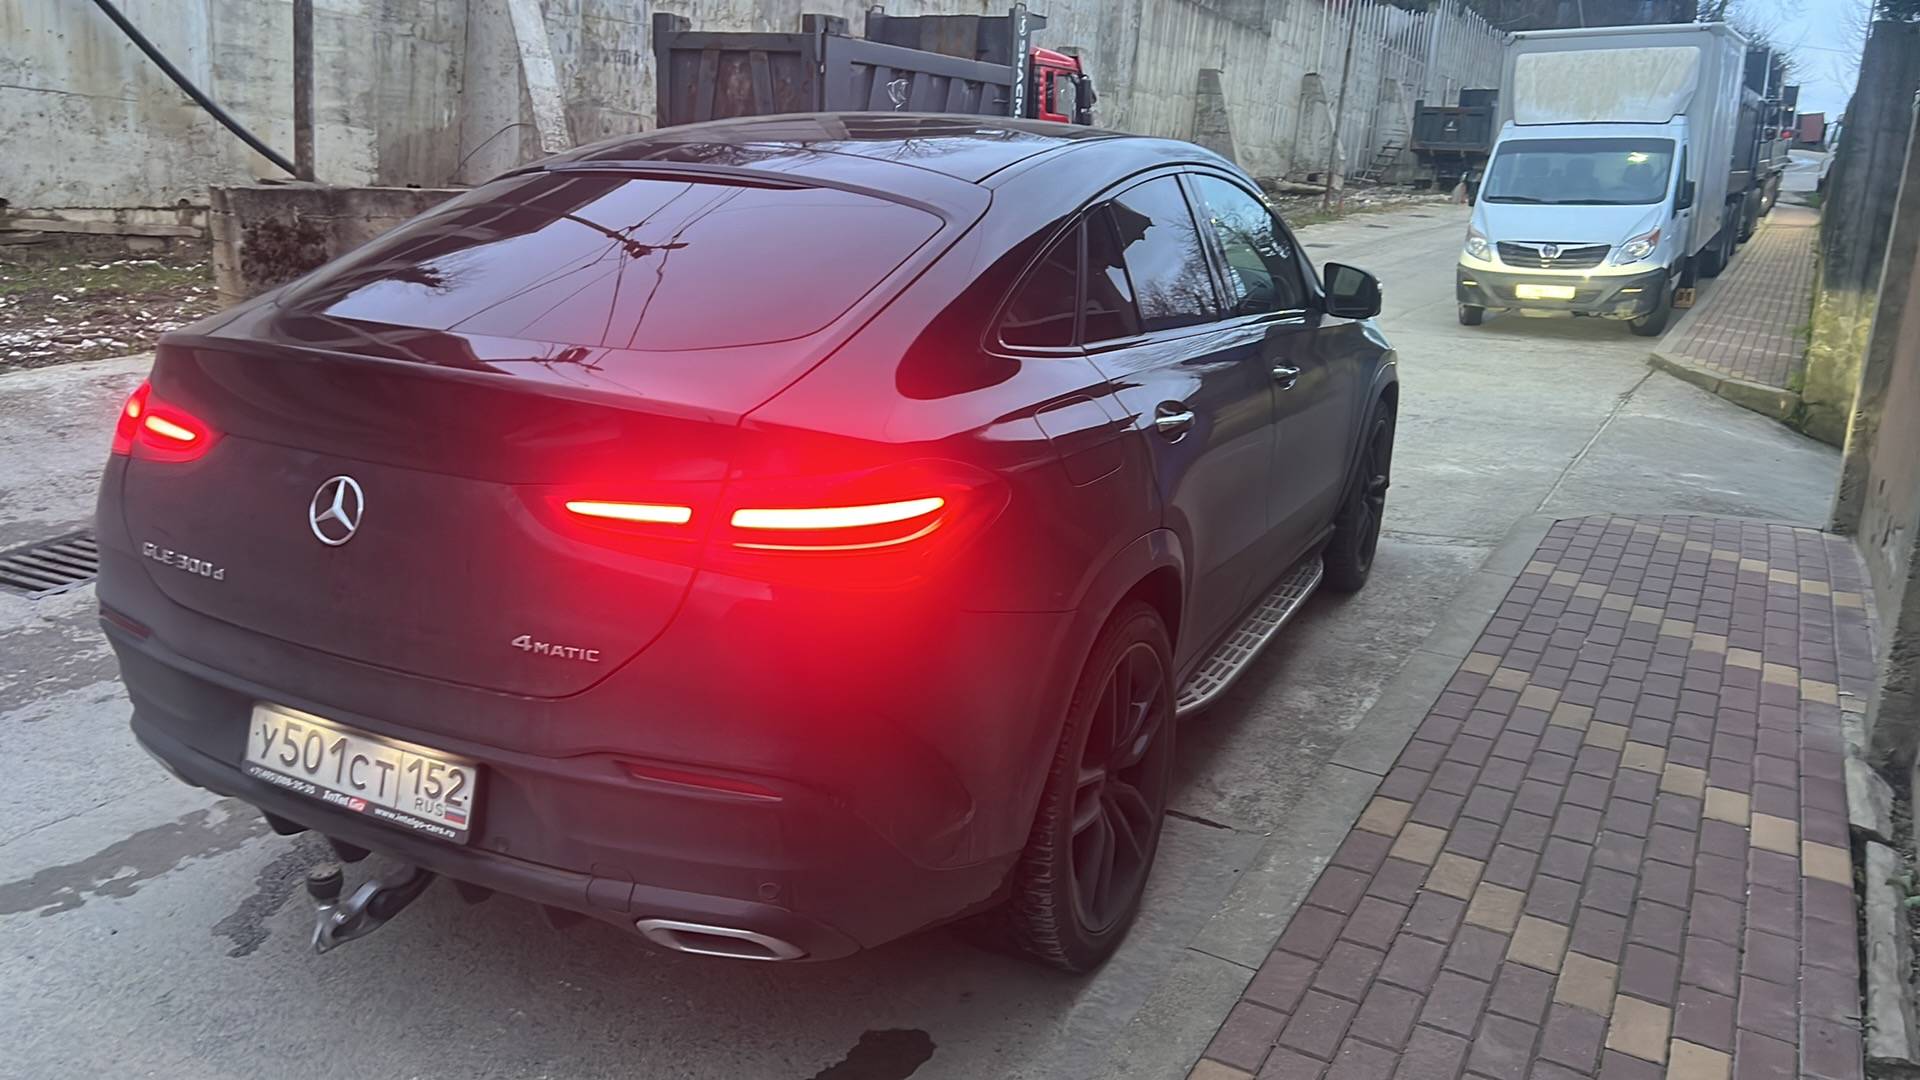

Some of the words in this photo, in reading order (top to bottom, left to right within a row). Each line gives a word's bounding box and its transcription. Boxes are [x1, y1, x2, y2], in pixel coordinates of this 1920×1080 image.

[1013, 39, 1026, 119] SHACM
[511, 634, 600, 662] 4MATIC
[407, 757, 465, 807] 152
[414, 797, 444, 817] RUS
